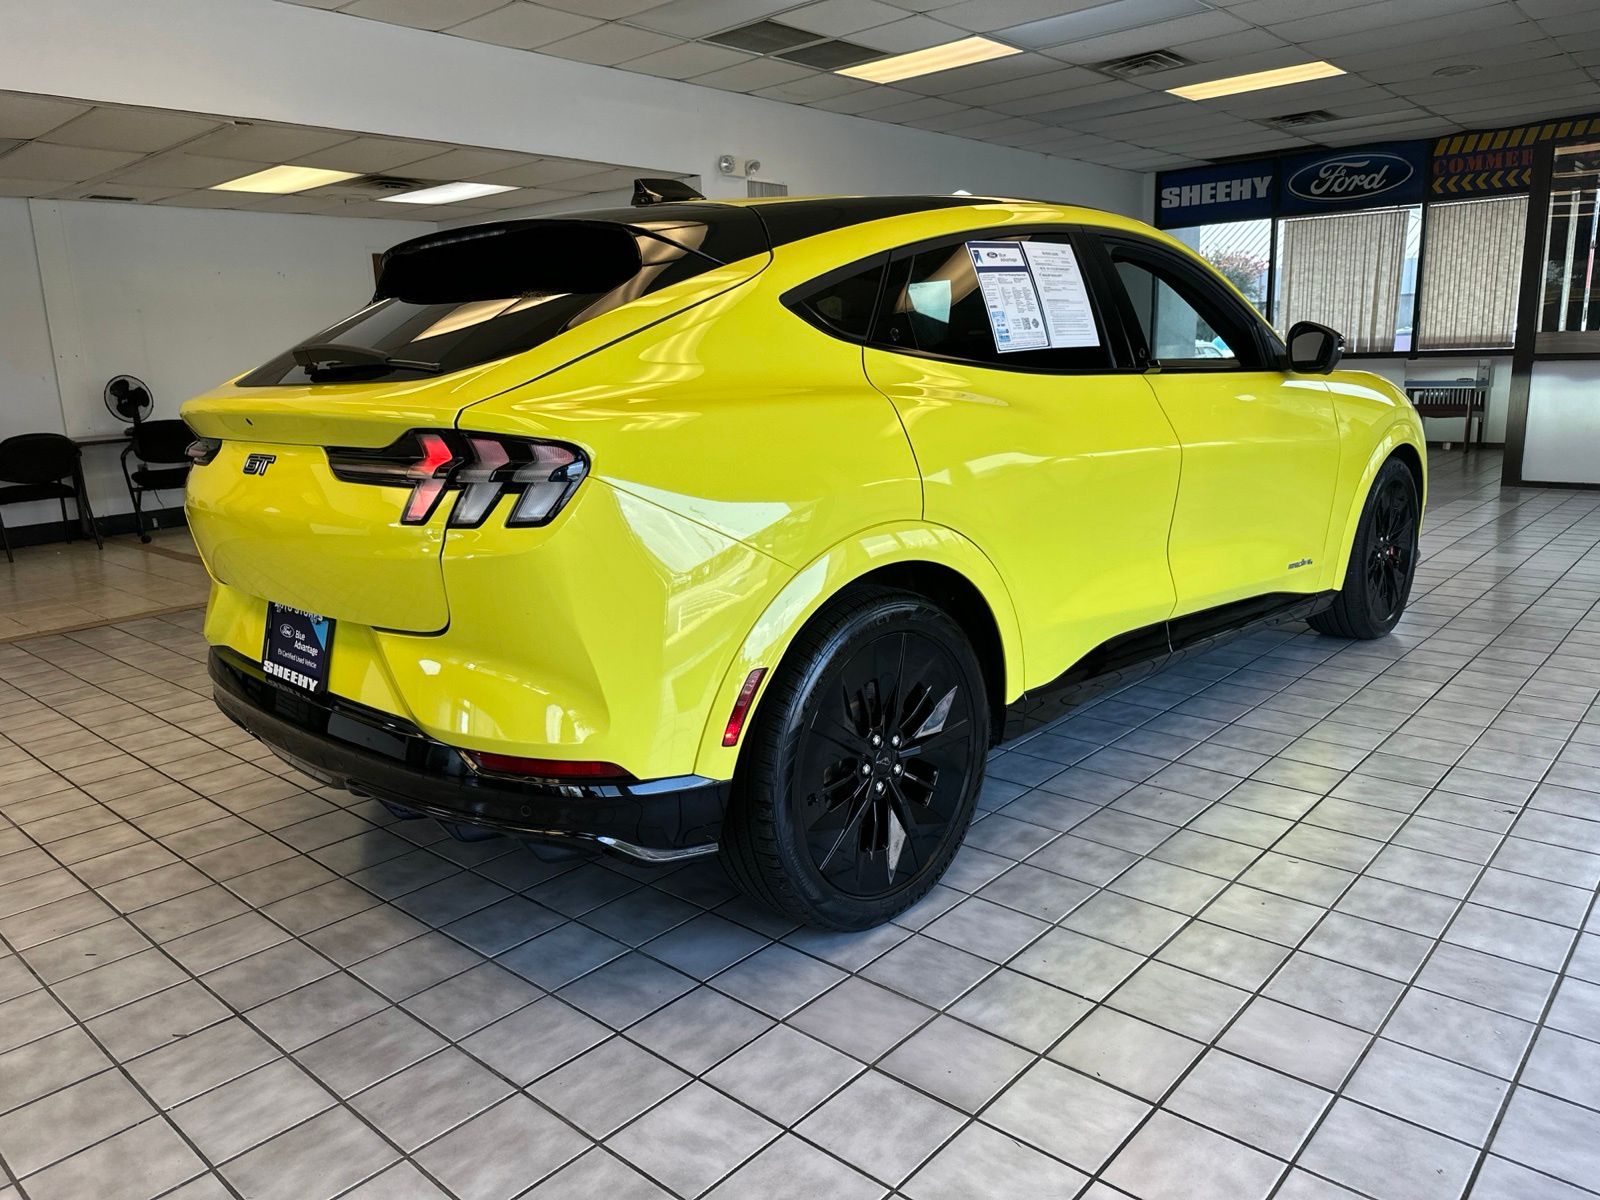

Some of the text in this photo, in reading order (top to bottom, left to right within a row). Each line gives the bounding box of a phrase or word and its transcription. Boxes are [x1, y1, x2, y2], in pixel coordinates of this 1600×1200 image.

[1310, 160, 1389, 195] Ford
[1161, 175, 1272, 208] SHEEHY
[243, 453, 276, 476] GT
[294, 640, 318, 657] Advantage
[295, 629, 306, 641] Blue
[263, 660, 319, 692] SHEEHY
